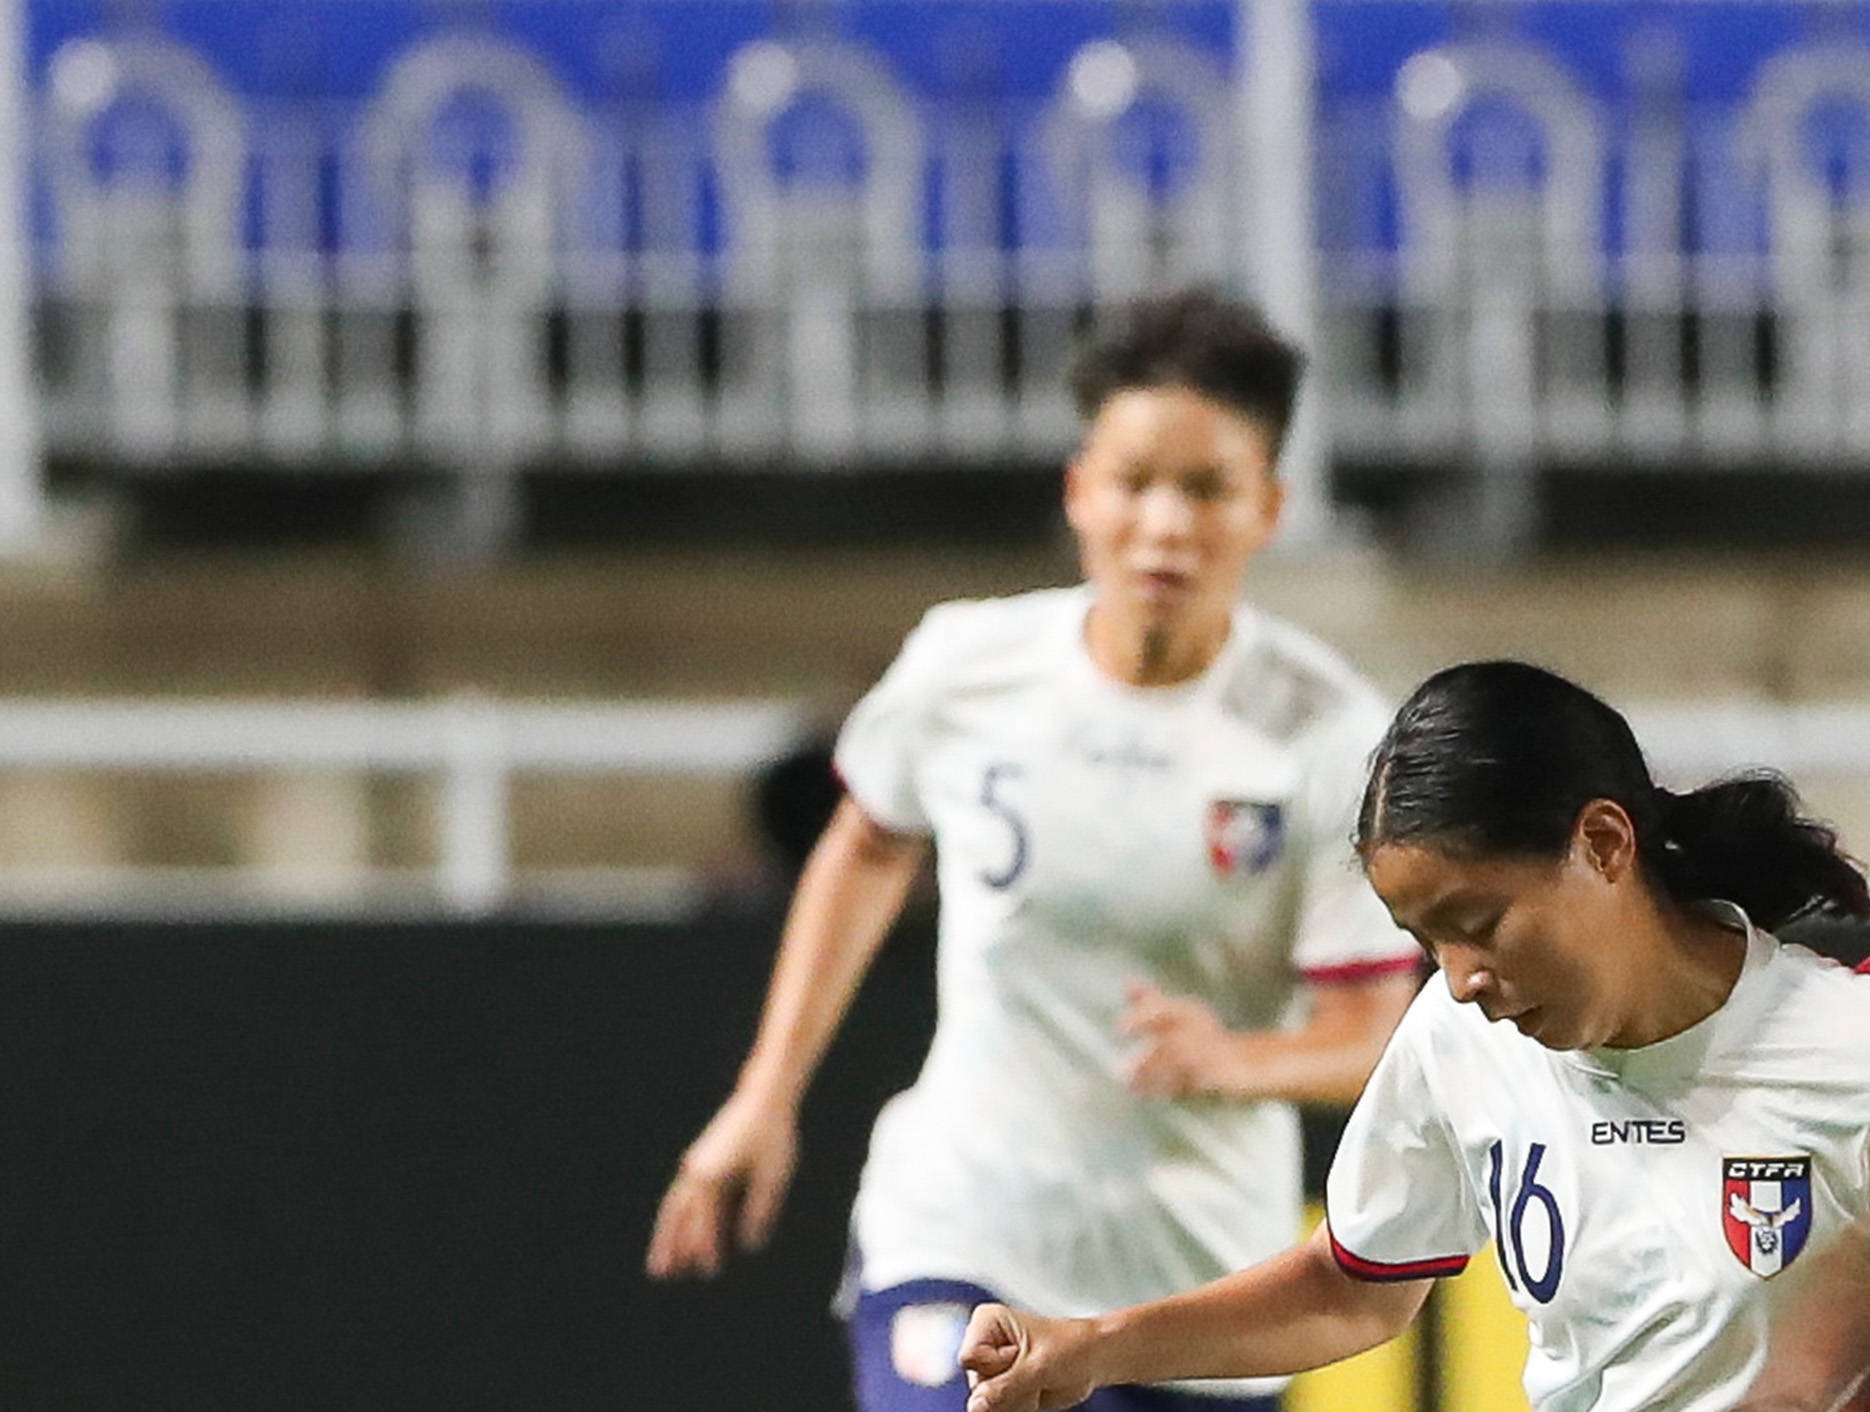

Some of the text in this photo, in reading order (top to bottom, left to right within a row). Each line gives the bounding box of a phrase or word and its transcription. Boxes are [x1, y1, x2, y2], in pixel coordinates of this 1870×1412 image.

[980, 761, 1029, 888] 5
[1591, 1121, 1685, 1144] ENTES
[1728, 1162, 1804, 1178] CTFA
[1490, 1138, 1564, 1303] 16
